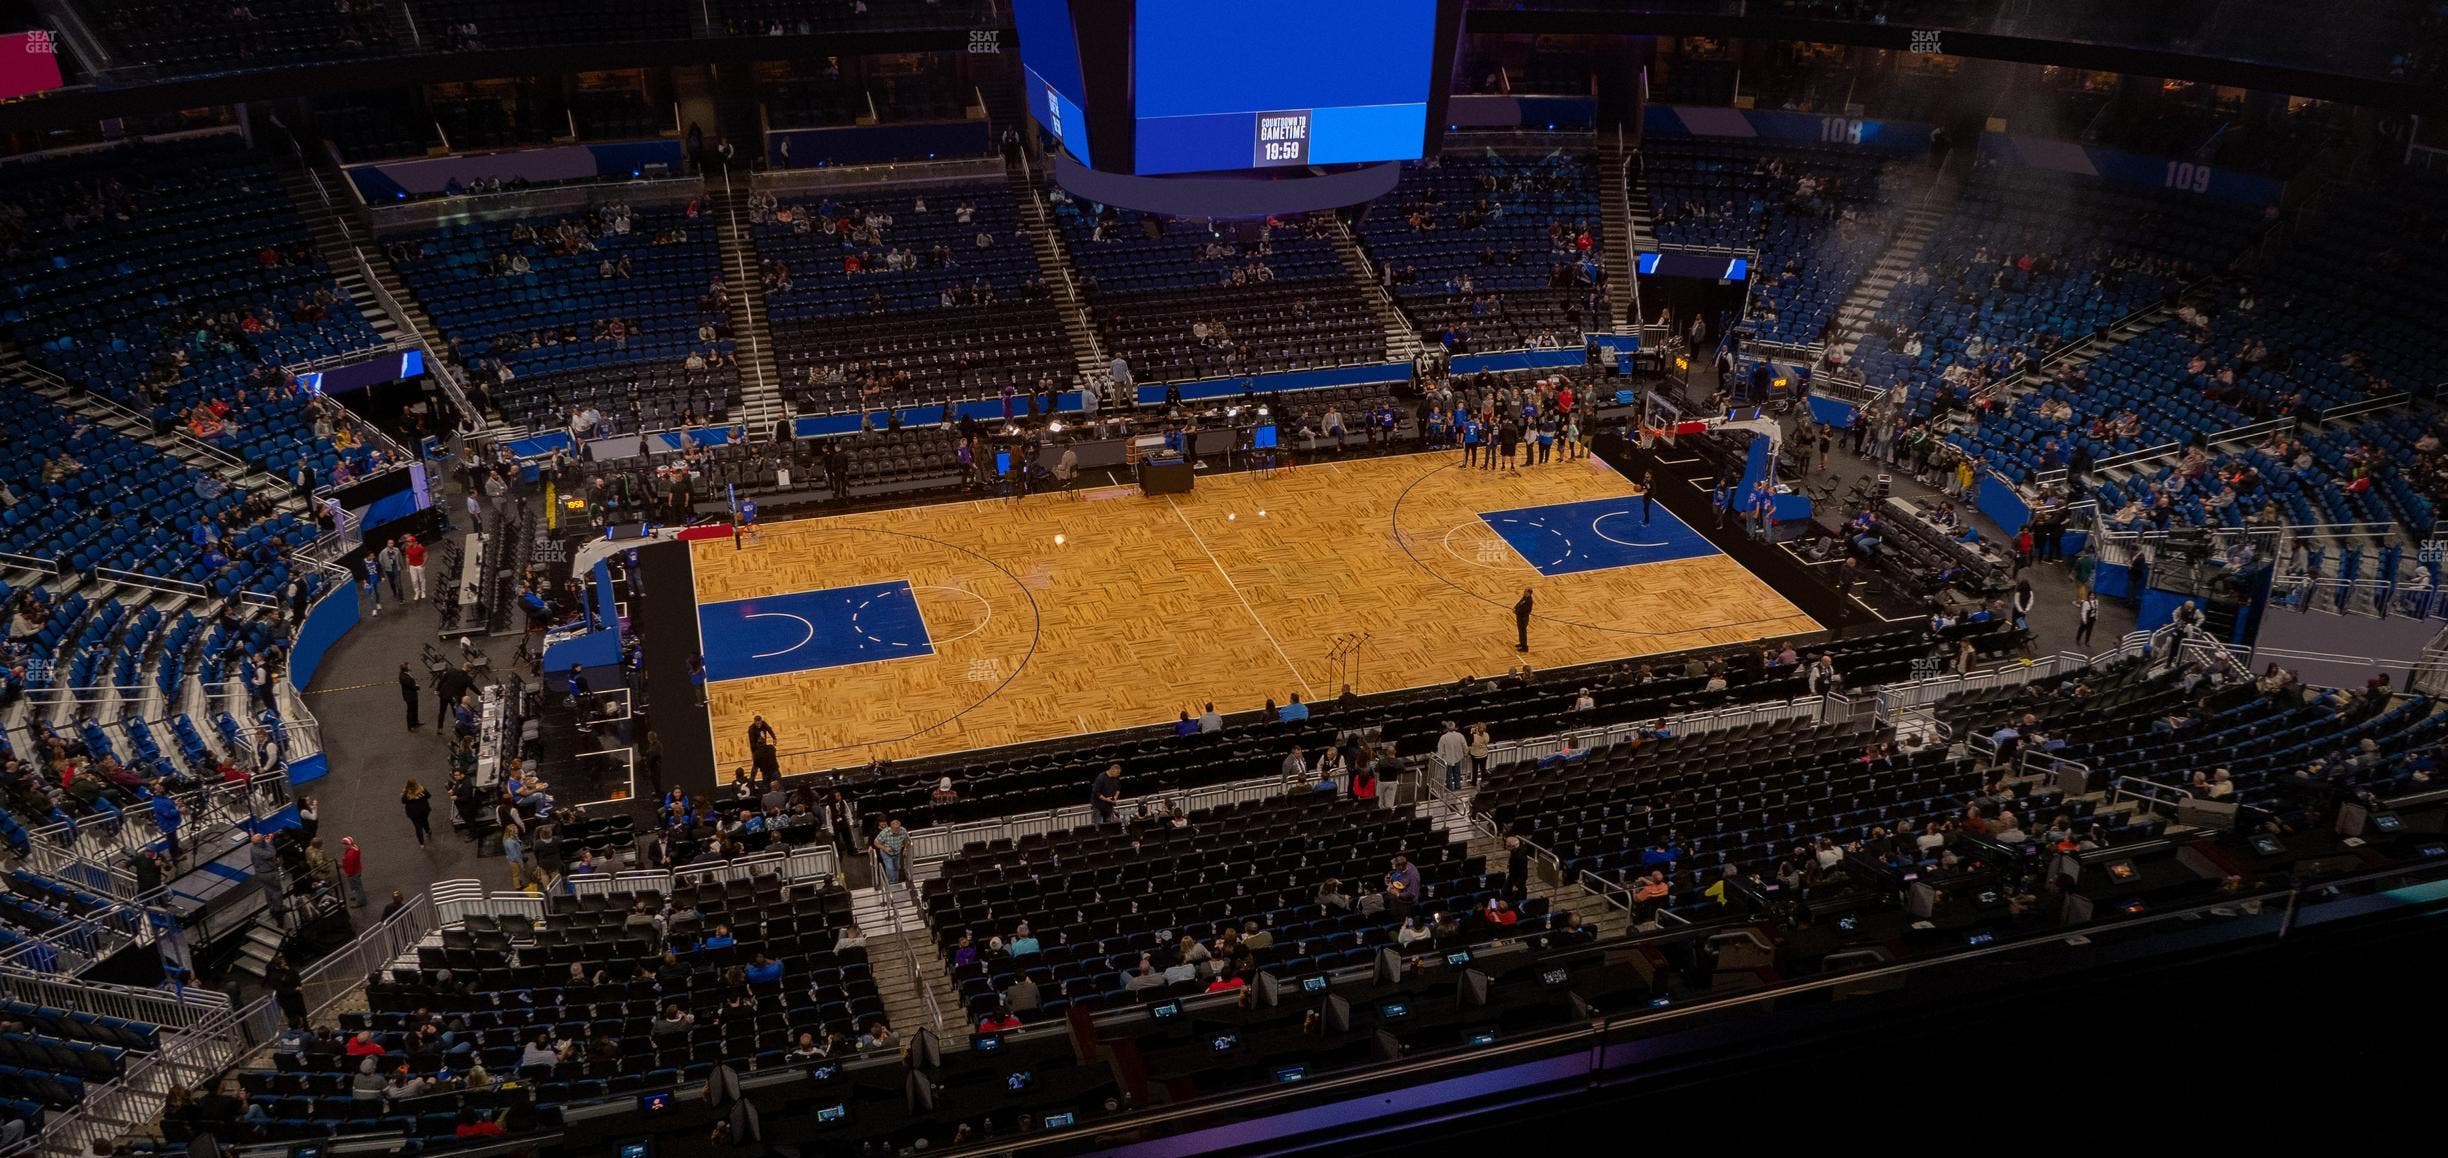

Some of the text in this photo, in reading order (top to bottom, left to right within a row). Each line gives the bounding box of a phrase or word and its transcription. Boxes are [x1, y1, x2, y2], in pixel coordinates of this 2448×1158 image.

[1261, 115, 1306, 128] COUNTDOWN TO
[1821, 117, 1863, 144] 108
[1261, 126, 1306, 141] GAMETIME
[1265, 141, 1299, 160] 19:59
[2165, 160, 2210, 194] 109
